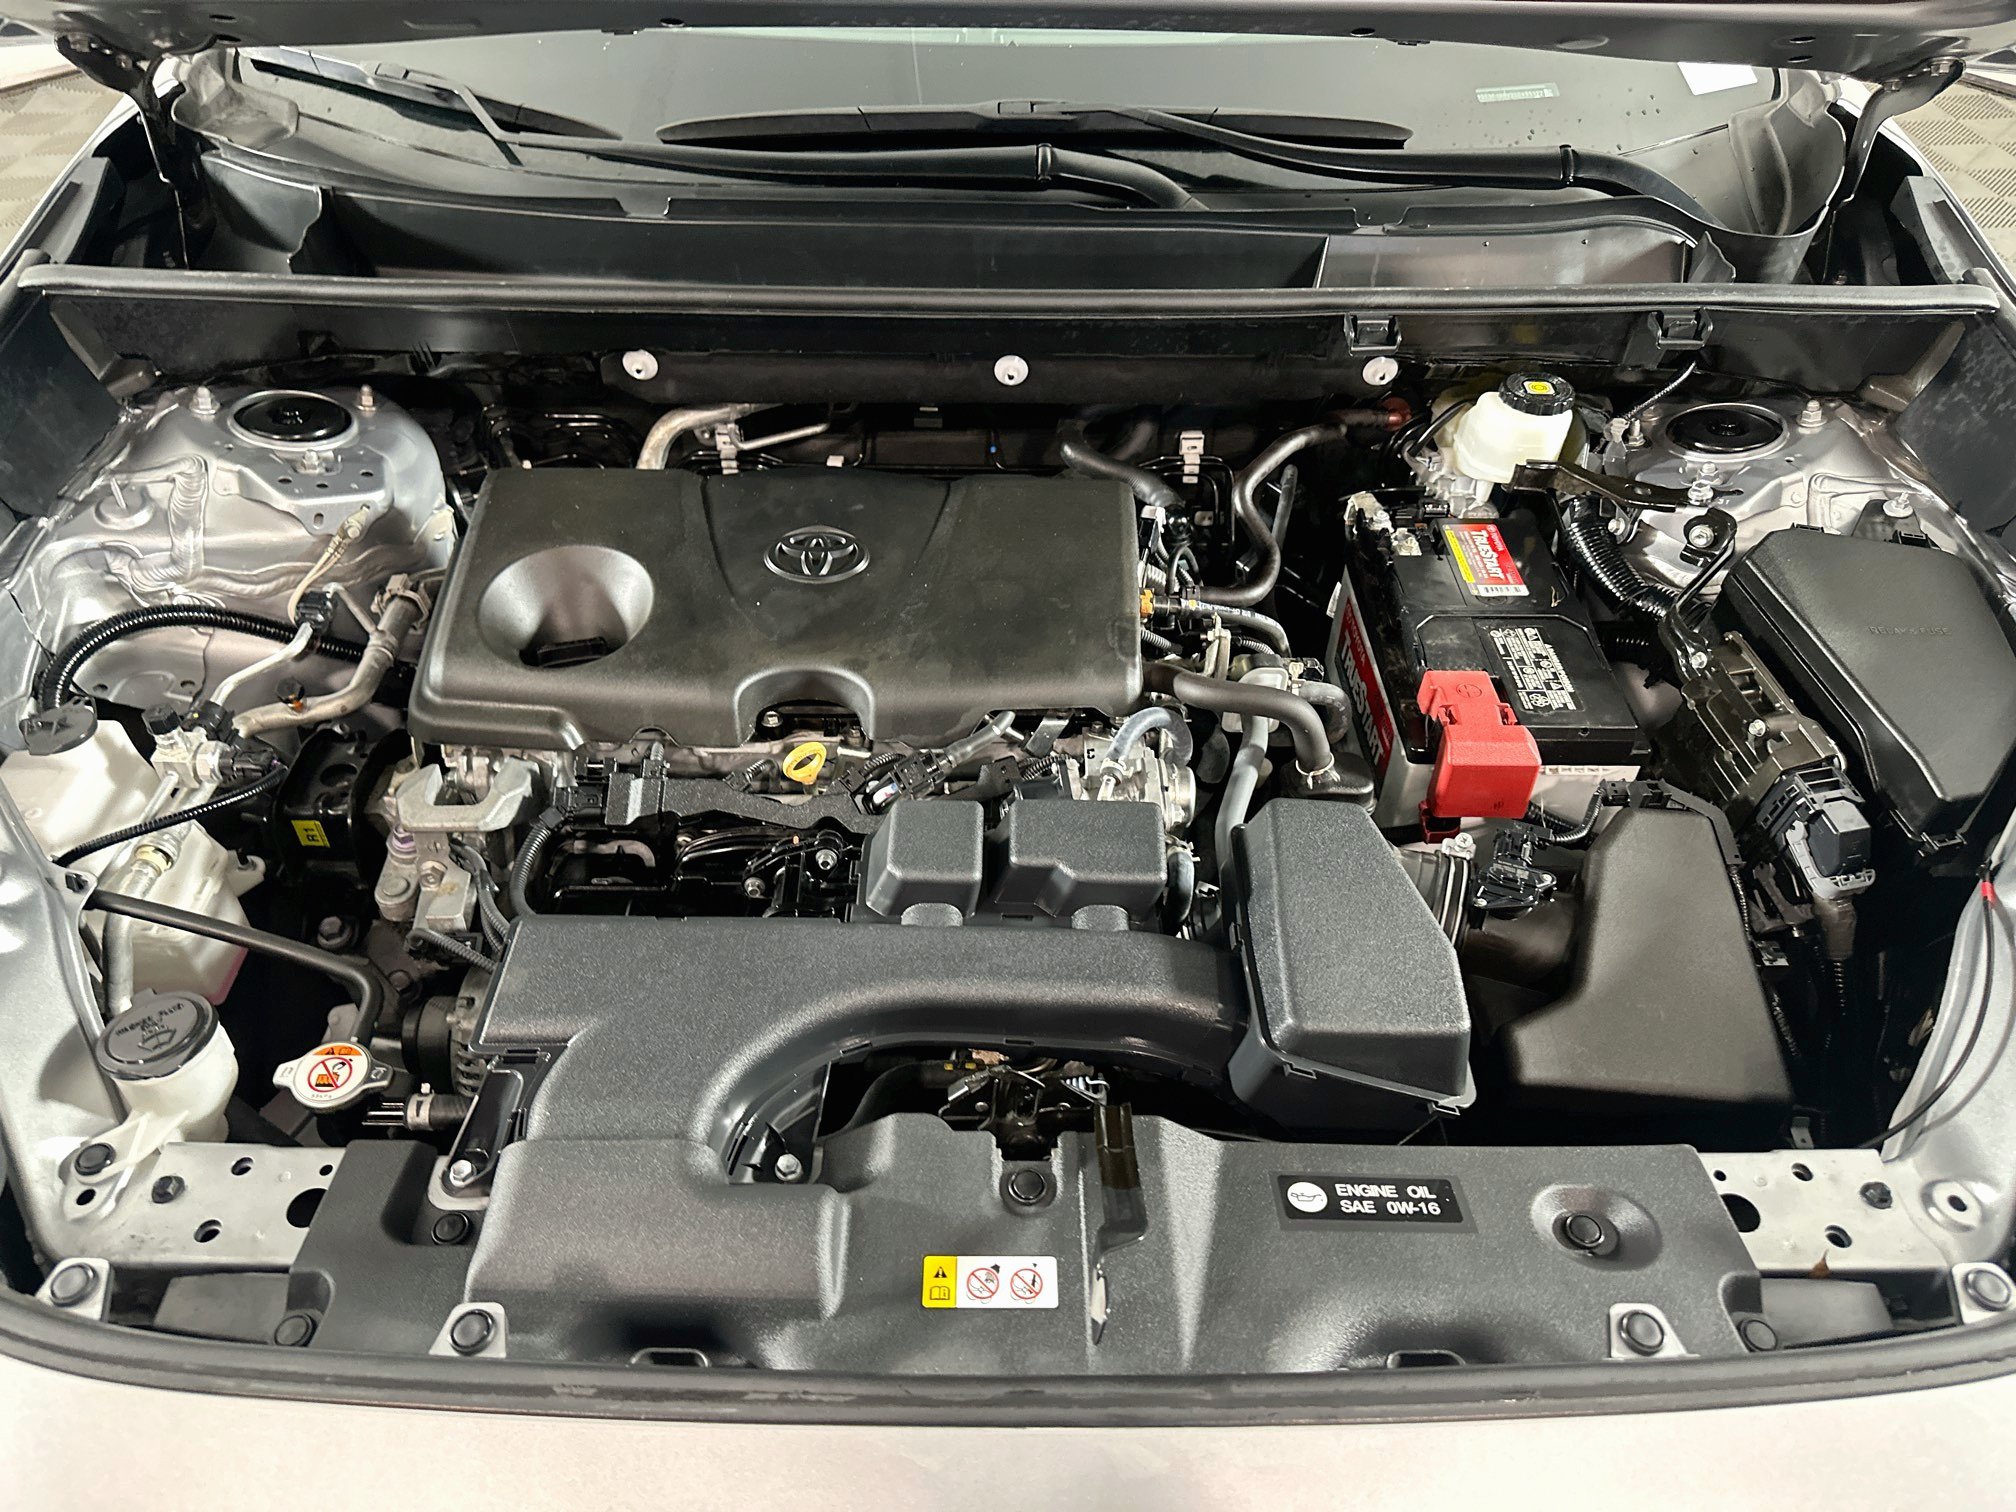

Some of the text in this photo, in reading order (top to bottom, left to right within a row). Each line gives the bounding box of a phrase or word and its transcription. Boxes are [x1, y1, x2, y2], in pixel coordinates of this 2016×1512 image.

[1334, 1183, 1437, 1199] ENGINE OIL
[1339, 1199, 1441, 1215] SAE 0W-16
